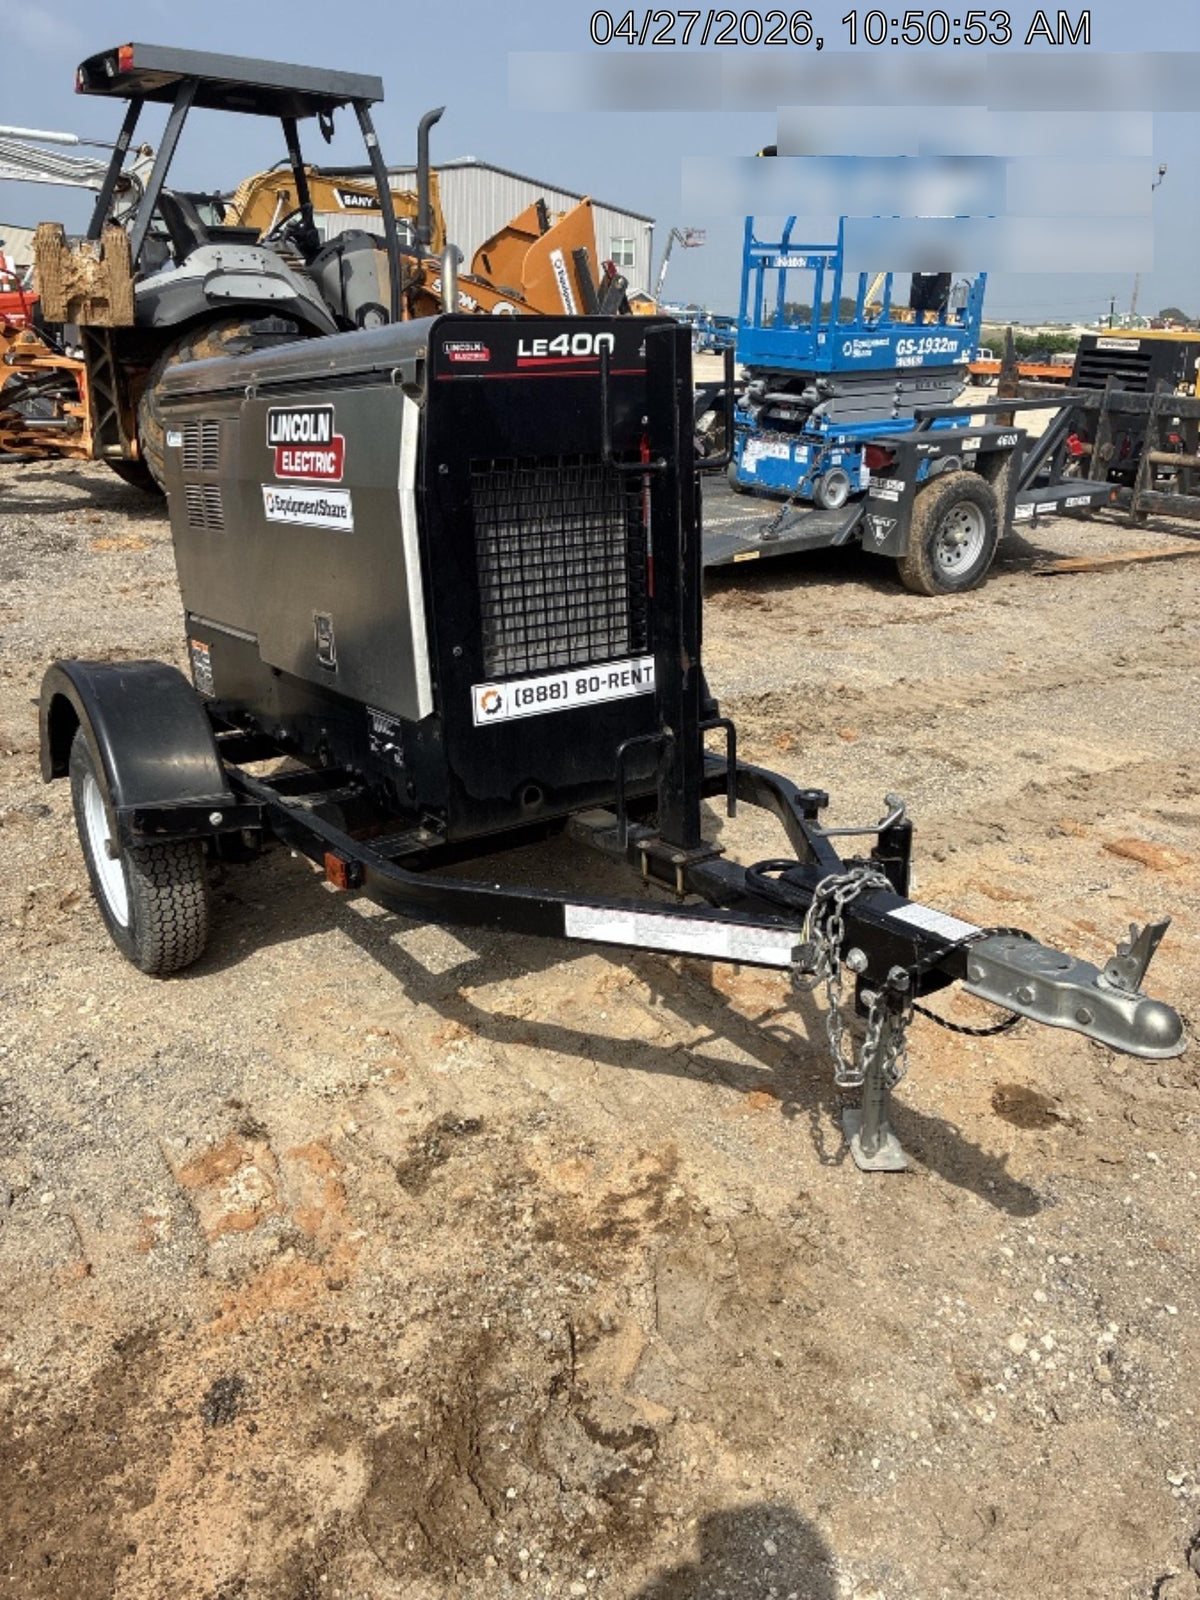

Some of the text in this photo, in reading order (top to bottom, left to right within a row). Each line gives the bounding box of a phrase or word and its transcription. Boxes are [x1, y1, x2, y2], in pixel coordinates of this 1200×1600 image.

[344, 195, 373, 207] SANY
[445, 343, 481, 352] LINCOLN
[517, 333, 615, 357] LE400
[896, 337, 958, 355] GS-1932m
[270, 413, 331, 442] LINCOLN
[282, 451, 337, 473] ELECTRIC
[515, 666, 653, 707] (888) 80-RENT
